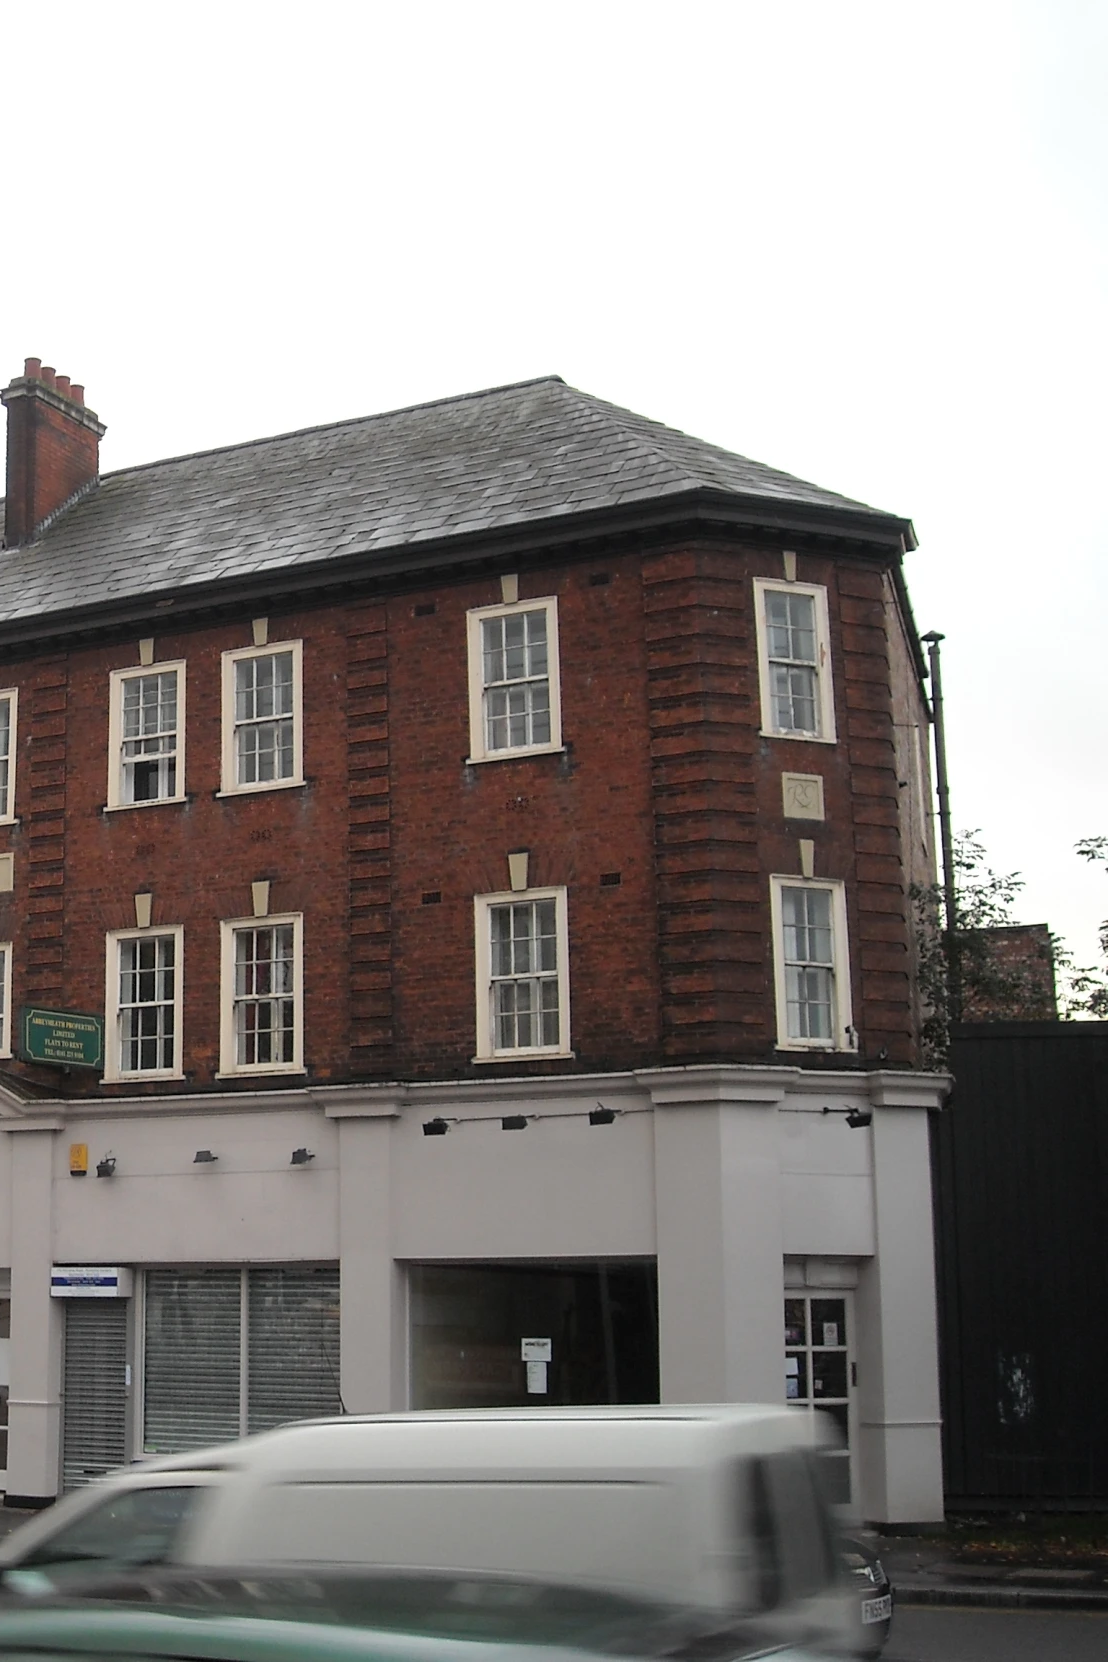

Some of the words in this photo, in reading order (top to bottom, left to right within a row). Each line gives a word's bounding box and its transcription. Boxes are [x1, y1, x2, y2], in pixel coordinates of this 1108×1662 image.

[52, 1030, 75, 1038] LIMITED
[45, 1039, 61, 1047] FLATS
[69, 1042, 83, 1050] RENT
